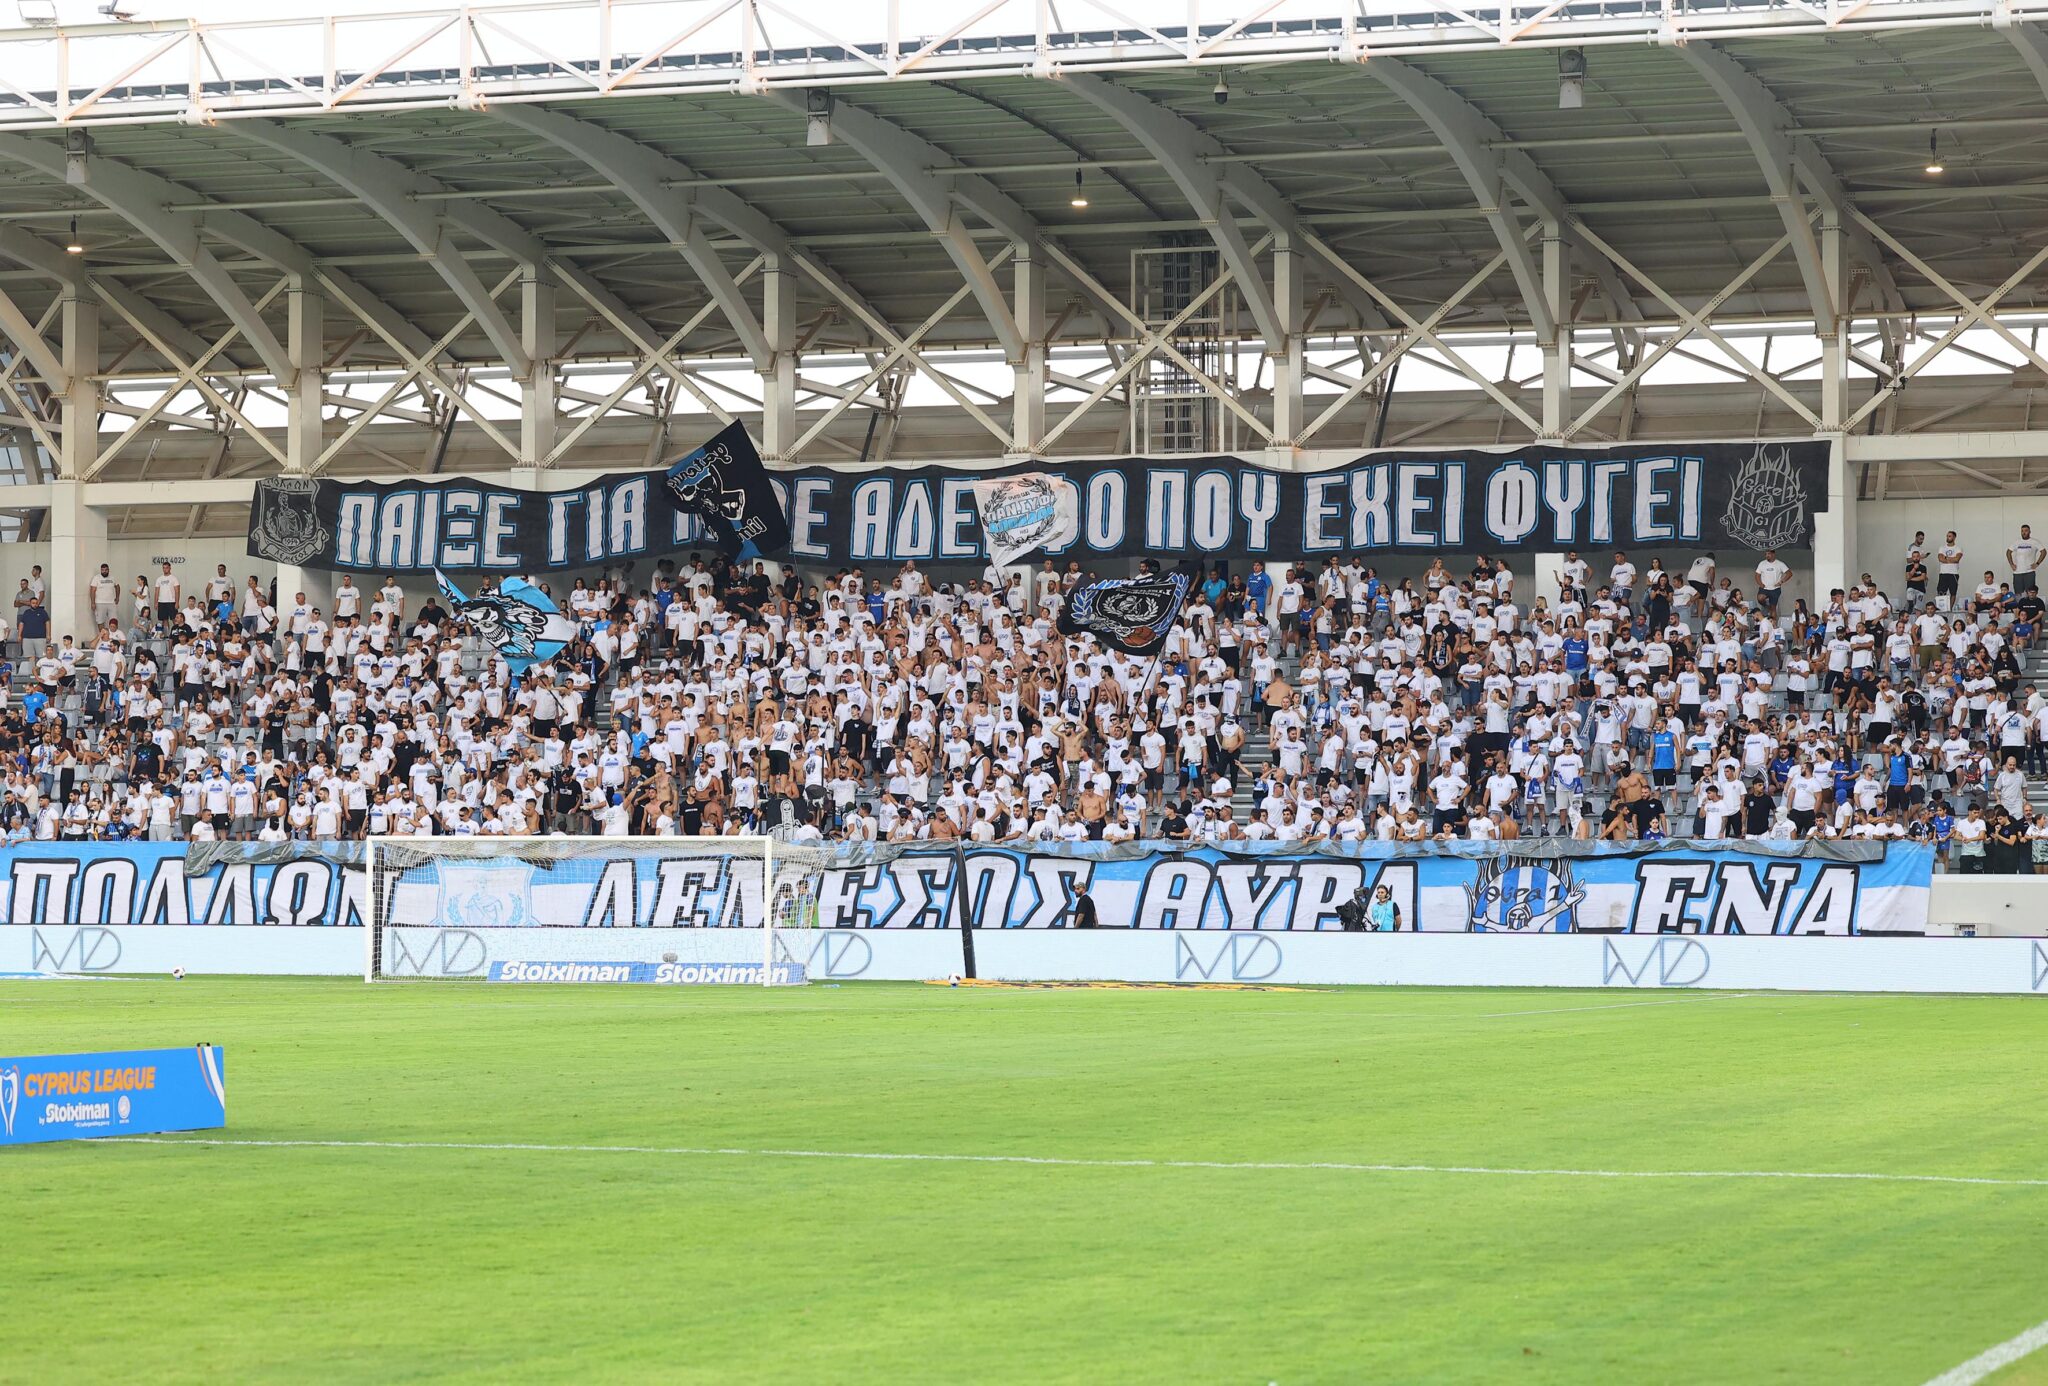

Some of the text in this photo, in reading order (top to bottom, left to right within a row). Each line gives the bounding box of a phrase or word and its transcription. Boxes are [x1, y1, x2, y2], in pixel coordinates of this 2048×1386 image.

[335, 488, 521, 568] ΠΑΙΞΕ
[548, 475, 649, 566] ΓΙΑ
[1145, 468, 1280, 551] ΠΟΥ
[1302, 461, 1466, 552] ΕΧΕΙ
[1486, 456, 1703, 545] ΦΥΓΕΙ
[1631, 859, 1860, 935] ΕΝΑ
[499, 961, 631, 982] Stoiximan
[654, 963, 790, 984] Stoiximan
[24, 1066, 156, 1097] CYPRUS LEAGUE
[45, 1102, 110, 1123] Stoiximan
